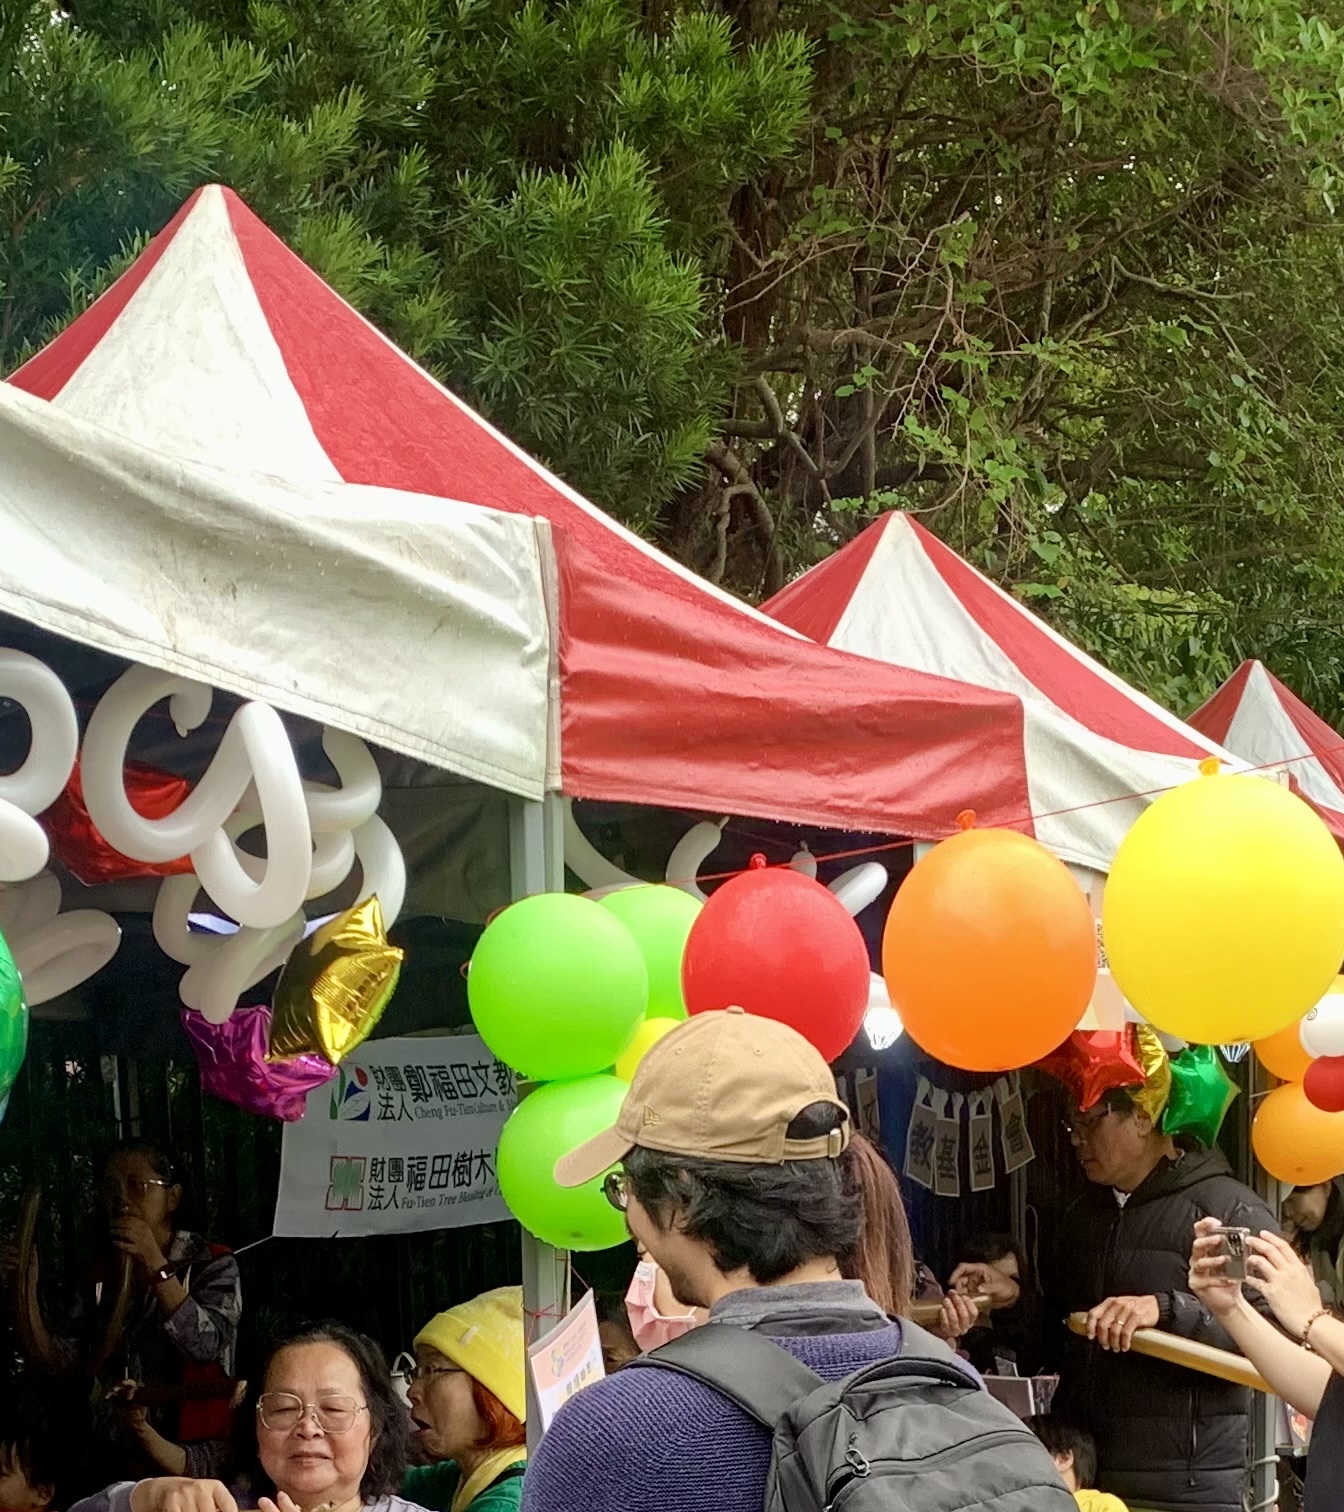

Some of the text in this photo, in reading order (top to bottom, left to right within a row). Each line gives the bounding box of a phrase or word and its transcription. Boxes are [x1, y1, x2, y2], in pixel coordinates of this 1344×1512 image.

[369, 1065, 407, 1092] 財團
[376, 1092, 414, 1121] 法人
[414, 1104, 443, 1120] Cheng
[369, 1148, 499, 1193] 財團 福田樹木
[367, 1184, 400, 1211] 法人
[400, 1195, 436, 1209] Fu-Tien
